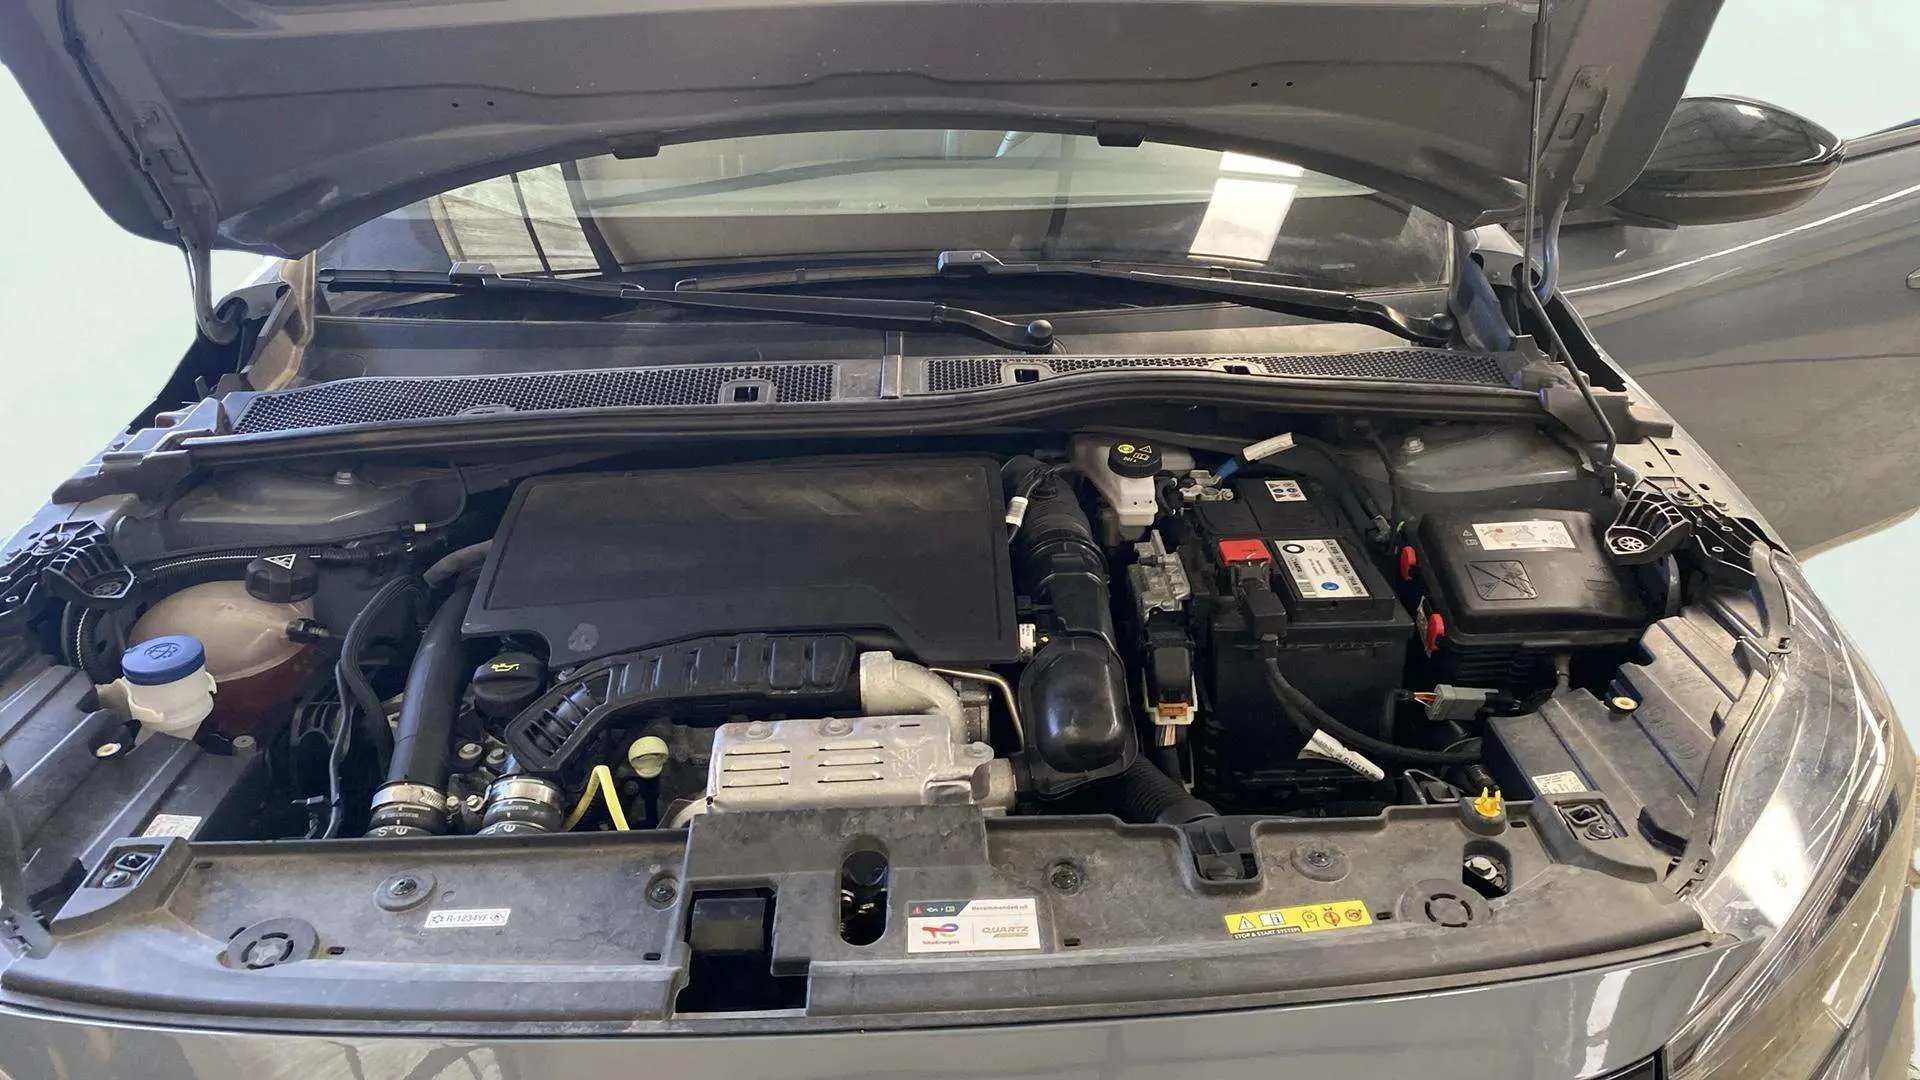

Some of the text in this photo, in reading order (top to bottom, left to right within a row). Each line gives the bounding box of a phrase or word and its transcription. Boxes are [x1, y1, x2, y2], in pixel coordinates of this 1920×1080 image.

[982, 926, 1029, 934] QUARTZ
[1234, 931, 1250, 939] STOP
[1257, 929, 1276, 937] START
[1277, 927, 1301, 935] SYSTEM
